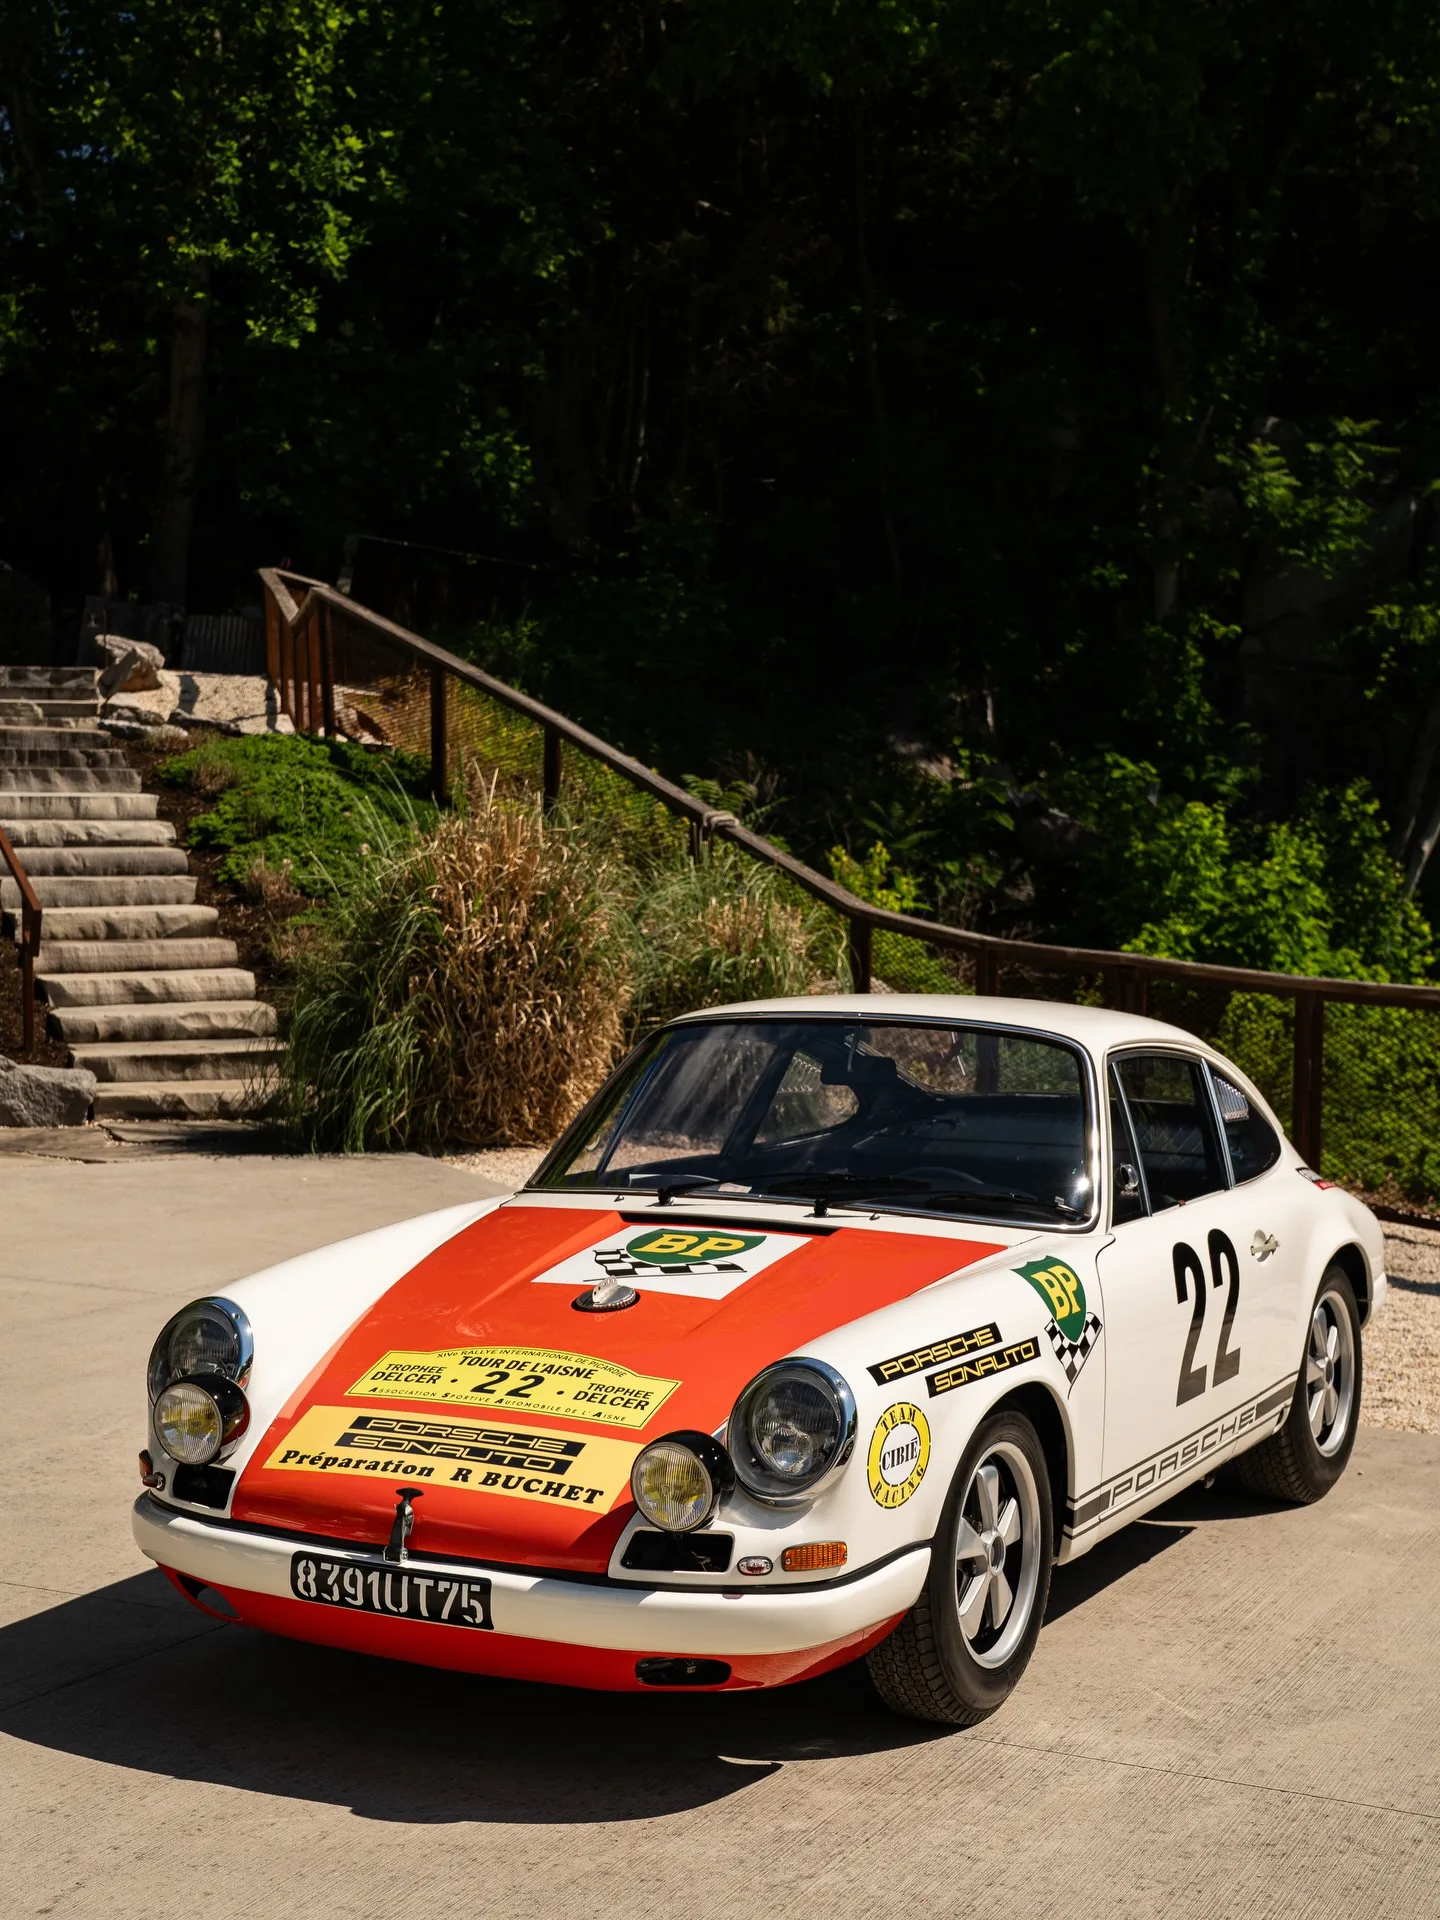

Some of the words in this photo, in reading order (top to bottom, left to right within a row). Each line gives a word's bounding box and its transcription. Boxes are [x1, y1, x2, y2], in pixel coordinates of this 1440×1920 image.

[632, 1233, 746, 1257] BP
[1030, 1265, 1081, 1321] BP
[1172, 1228, 1241, 1408] 22
[385, 1364, 447, 1374] TROPHEE
[459, 1356, 506, 1369] TOUR
[504, 1360, 532, 1371] DE
[529, 1363, 599, 1379] L'AISNE
[499, 1349, 573, 1362] INTERNATIONAL
[590, 1360, 628, 1378] PICARDIE
[879, 1328, 995, 1380] PORSCHE
[934, 1341, 1035, 1392] SONAUTO
[370, 1372, 441, 1384] DELCER
[469, 1371, 545, 1399] 22
[587, 1383, 655, 1400] TROPHEE
[573, 1391, 650, 1411] DELCER
[366, 1419, 568, 1453] PORSCHE
[881, 1407, 916, 1432] TEAM
[350, 1435, 556, 1471] SONAUTO
[882, 1437, 918, 1471] CIBIÉ
[1111, 1405, 1256, 1506] PORSCHE
[279, 1449, 435, 1477] Préparation
[450, 1467, 473, 1482] R
[479, 1471, 604, 1504] BUCHET
[873, 1464, 924, 1503] RACING
